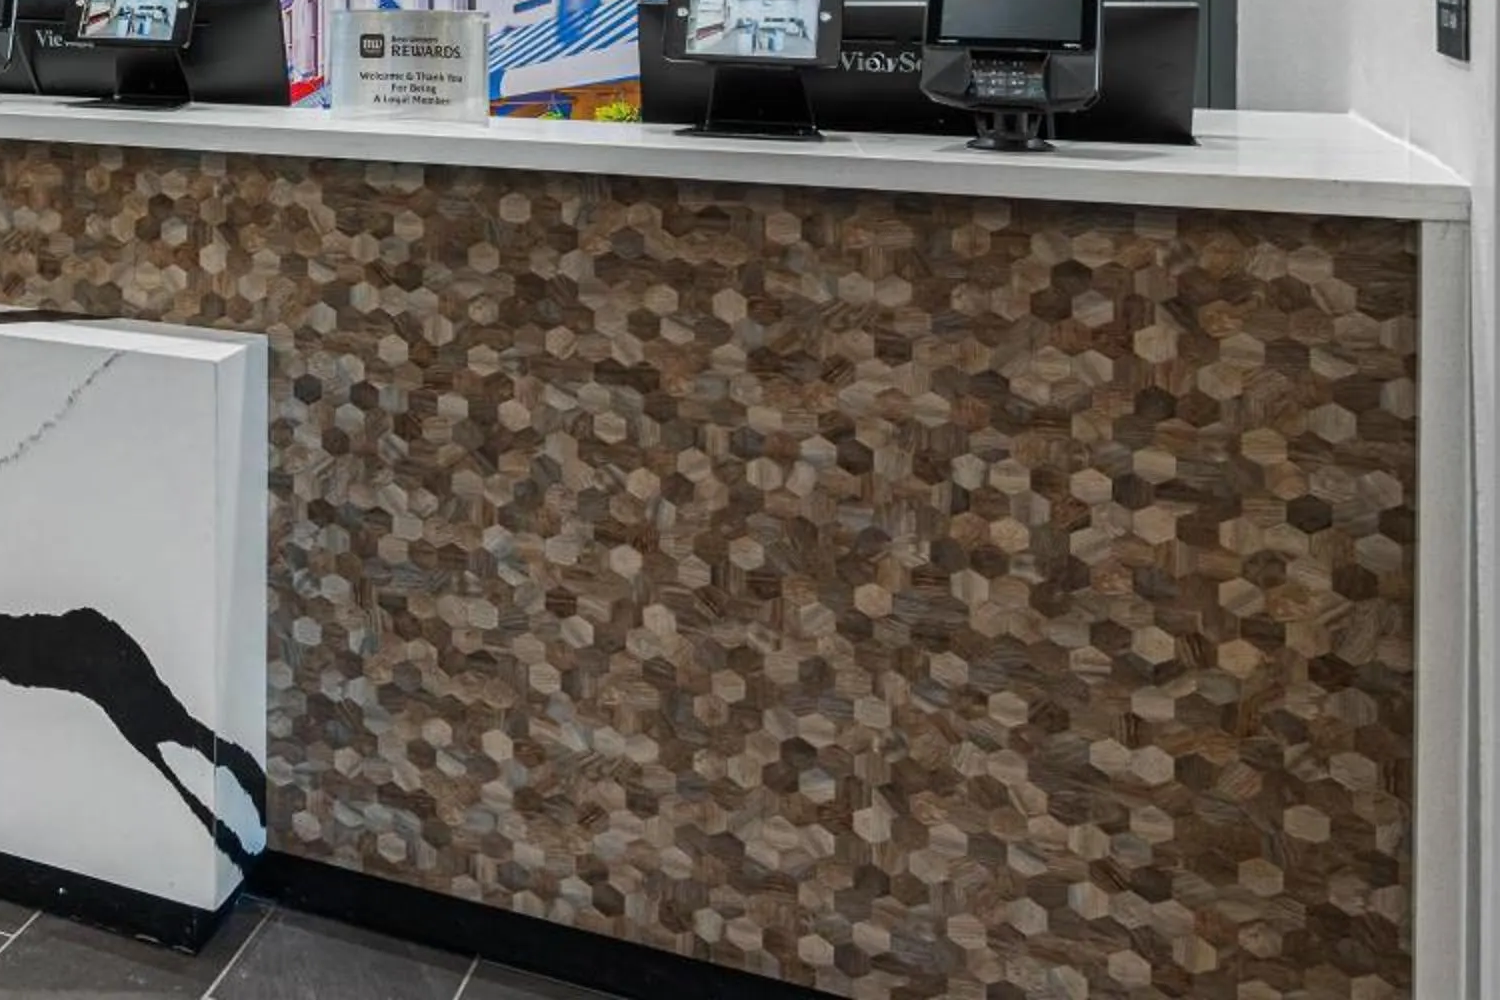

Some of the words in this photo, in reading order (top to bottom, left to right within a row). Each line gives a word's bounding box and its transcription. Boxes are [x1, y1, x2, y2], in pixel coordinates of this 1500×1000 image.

[359, 71, 404, 81] Welcome
[415, 71, 445, 82] Thank
[446, 73, 463, 83] You
[390, 83, 408, 93] For
[409, 83, 437, 95] Being
[373, 94, 381, 104] A
[411, 95, 450, 105] Member
